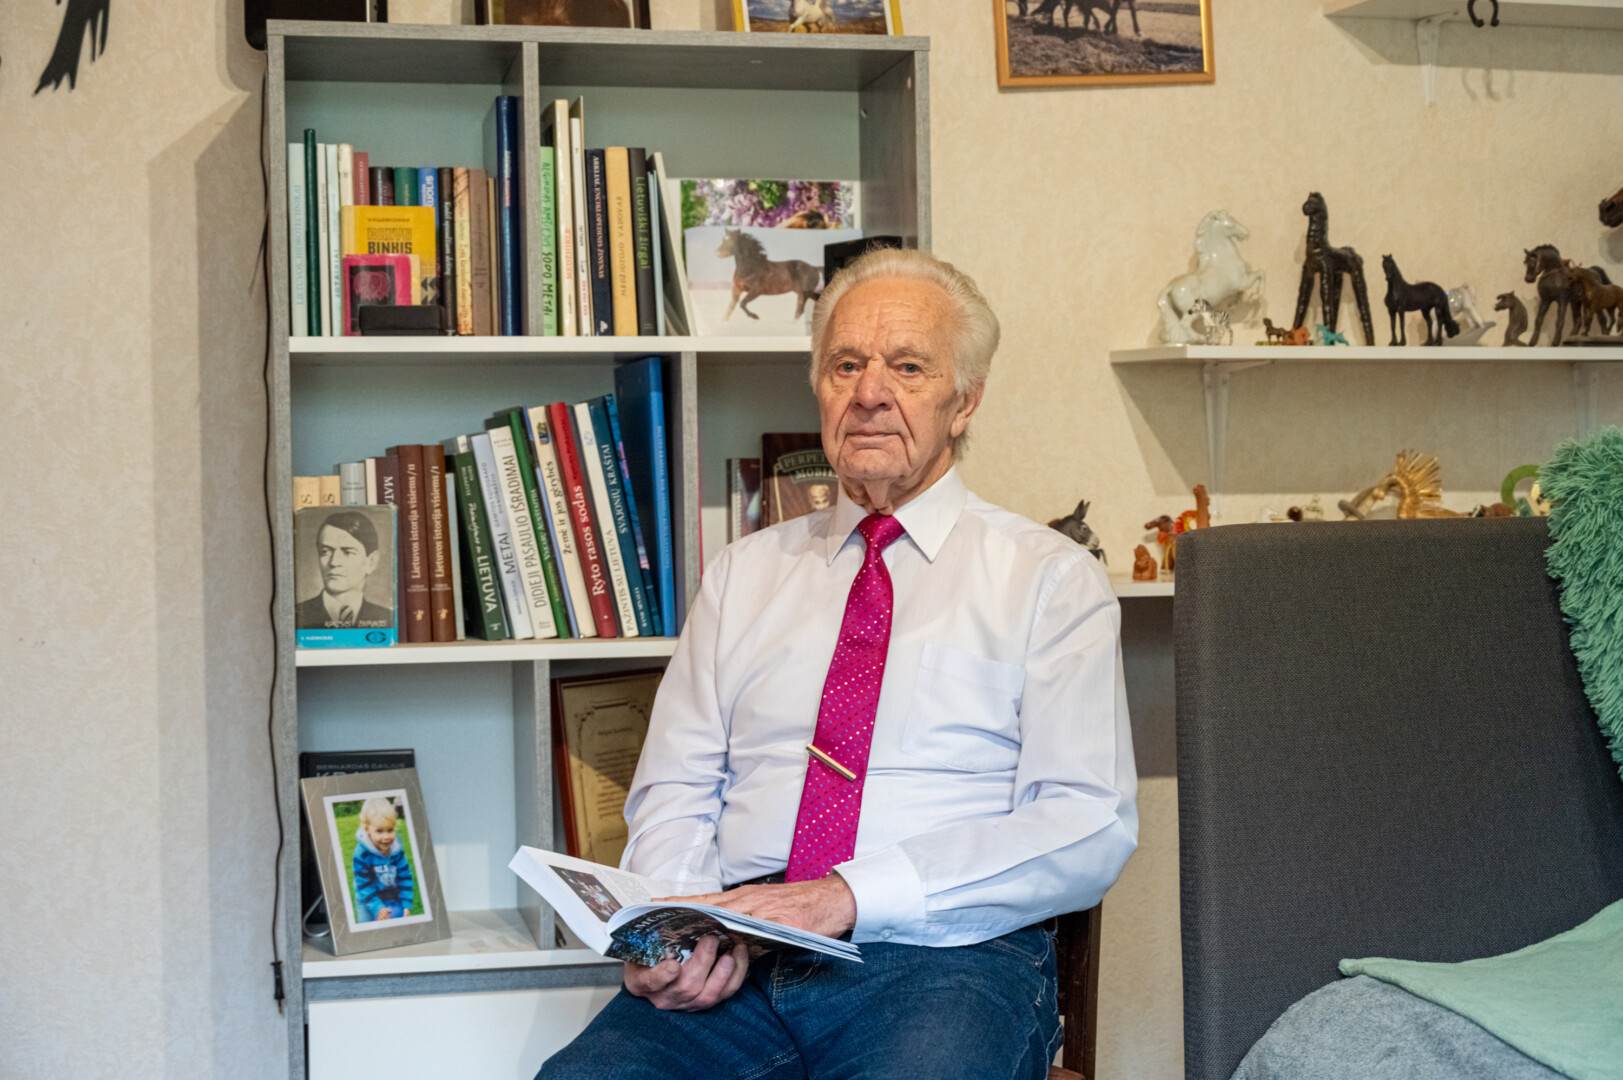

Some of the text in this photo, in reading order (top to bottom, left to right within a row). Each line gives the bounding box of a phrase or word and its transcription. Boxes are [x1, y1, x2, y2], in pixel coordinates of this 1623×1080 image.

[594, 188, 604, 248] ENCIKLOPEDINIS
[636, 176, 650, 269] Lietuviški žirgai
[368, 242, 412, 254] BINKIS
[542, 252, 553, 278] SODO
[597, 249, 606, 278] ŽINYNAS
[616, 196, 627, 296] MEDŽIOTOJO VADOVAS
[542, 283, 554, 316] METAI
[544, 460, 563, 498] gėrybės
[600, 444, 618, 486] KRAŠTAI
[502, 455, 526, 514] IŠRADIMAI
[530, 488, 545, 531] AUKŠTAITIJA
[553, 501, 566, 515] jos
[568, 485, 589, 524] sodas
[610, 488, 629, 534] SVAJONIŲ
[408, 510, 419, 540] istorija
[432, 508, 443, 540] istorija
[514, 515, 539, 568] PASAULIO
[560, 528, 573, 555] Žemė
[411, 542, 420, 578] Lietuvos
[434, 541, 444, 578] Lietuvos
[497, 532, 517, 574] METAI
[539, 532, 551, 560] VAKARŲ
[580, 526, 598, 561] rasos
[477, 554, 497, 613] LIETUVA
[526, 570, 548, 608] DIDIEJI
[587, 562, 608, 596] Ryto
[605, 529, 634, 632] PAŽINTIS SU LIETUVA
